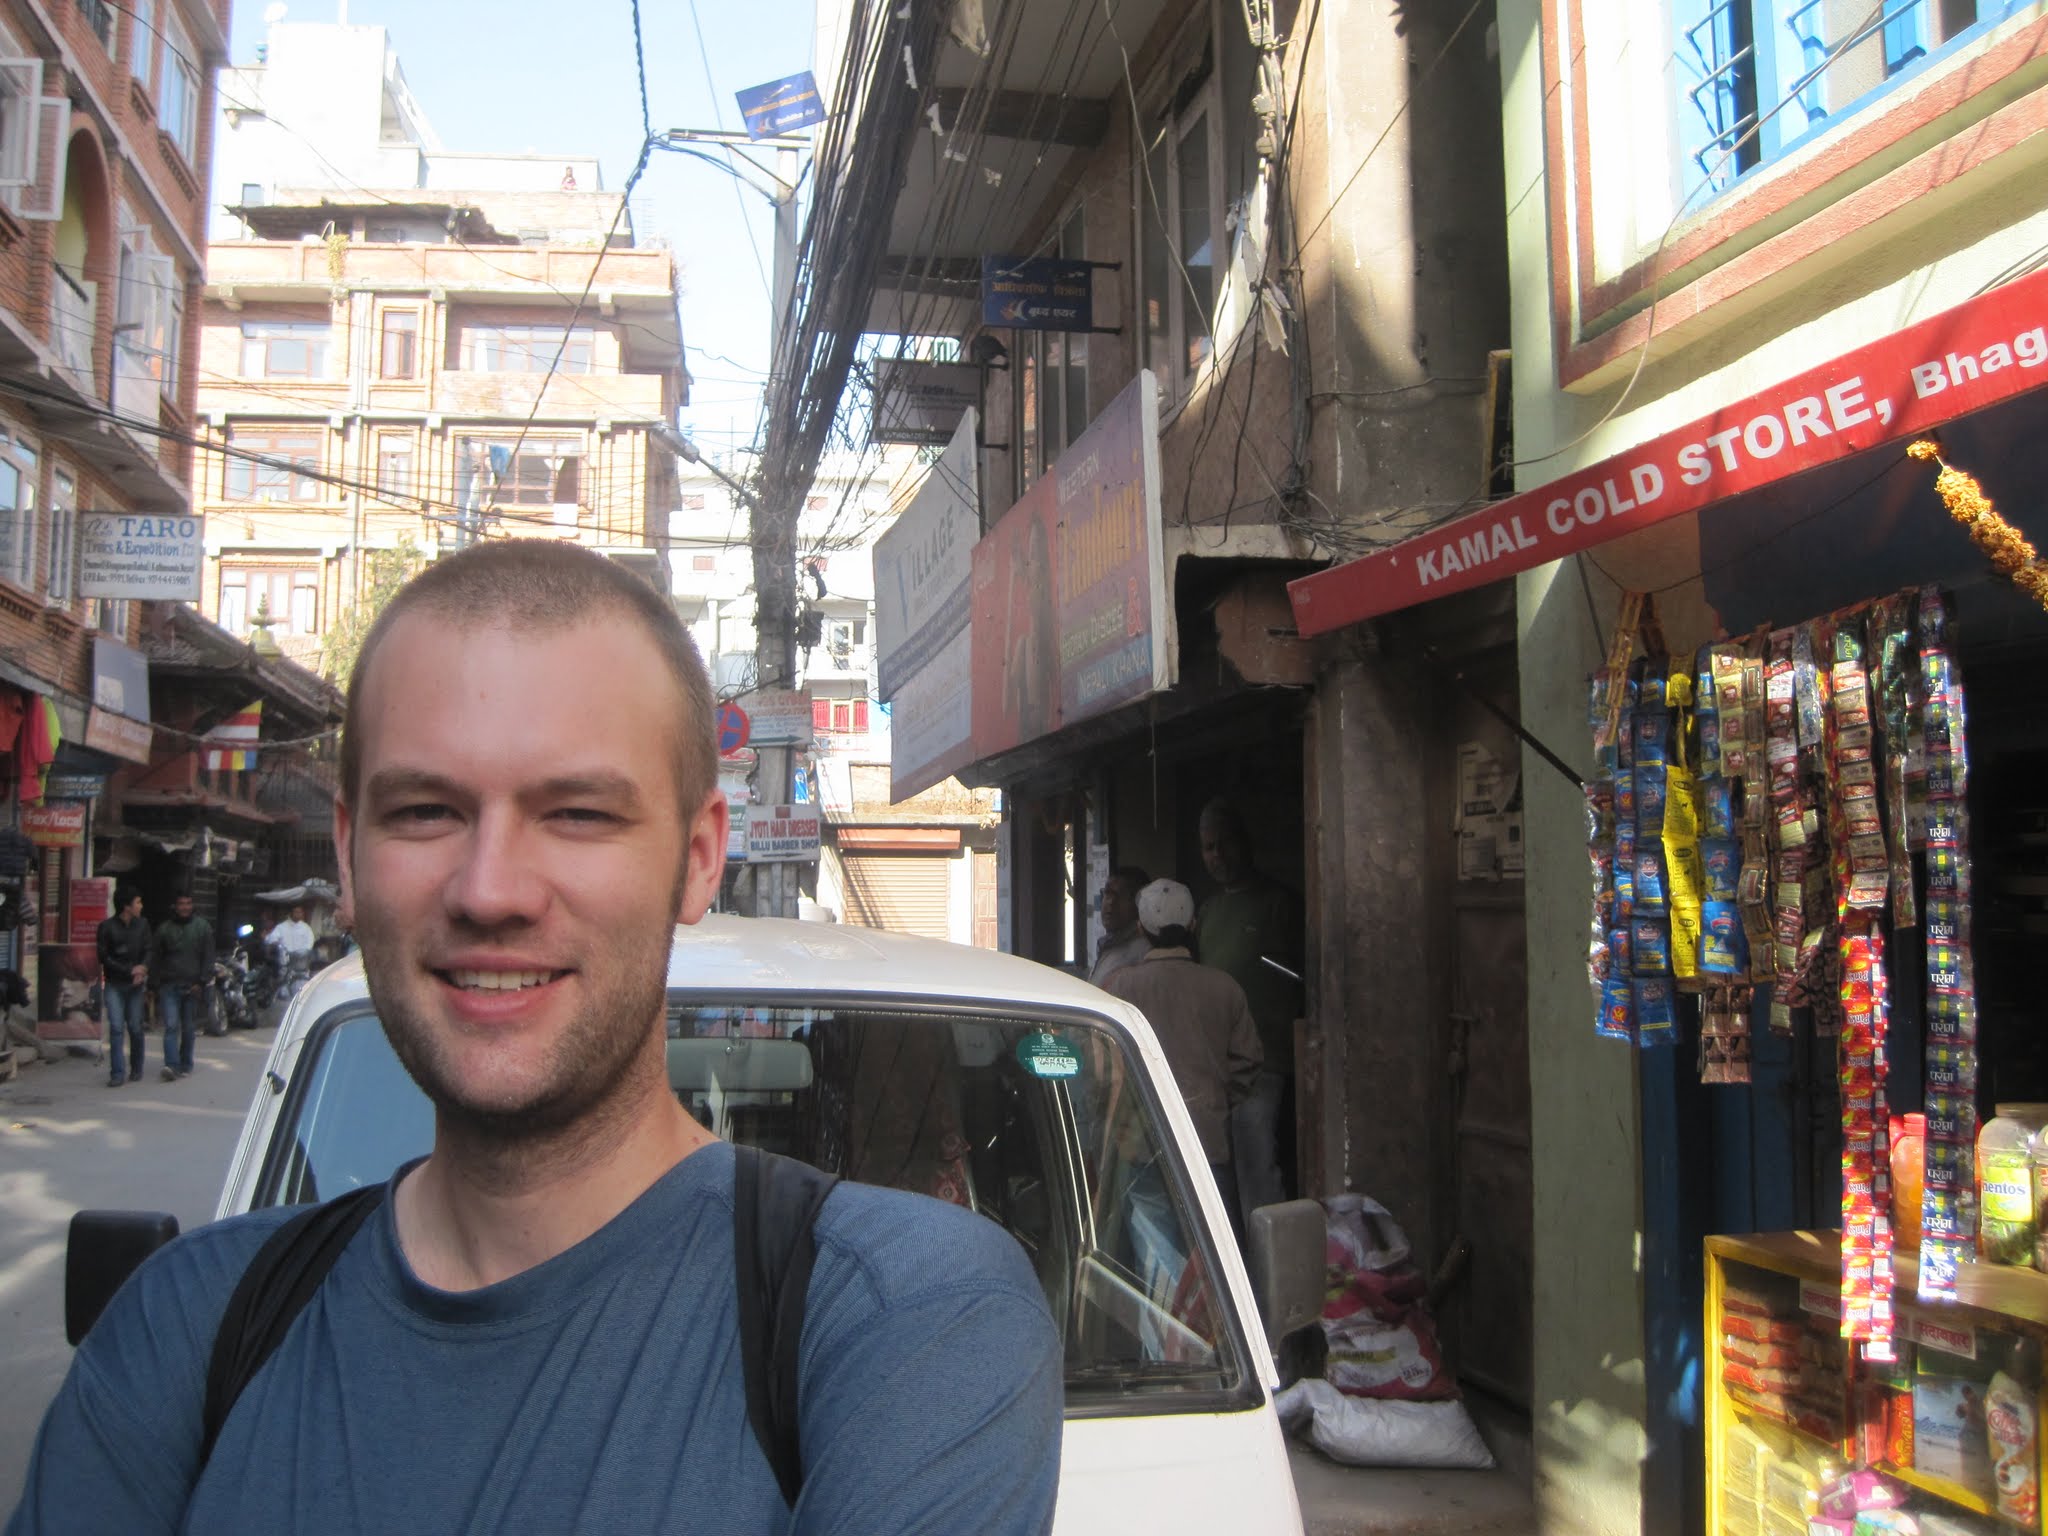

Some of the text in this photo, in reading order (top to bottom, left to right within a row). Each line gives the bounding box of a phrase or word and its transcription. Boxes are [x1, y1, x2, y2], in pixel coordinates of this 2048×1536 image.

[1416, 327, 2048, 586] KAMAL COLD STORE, Bhag
[118, 518, 195, 538] TARO
[750, 819, 818, 838] JYOTI HAIR DRESSER
[772, 840, 799, 850] BARBER
[800, 839, 819, 849] SHOP
[1847, 1013, 1870, 1025] Pinky
[1847, 1224, 1871, 1237] Pinky
